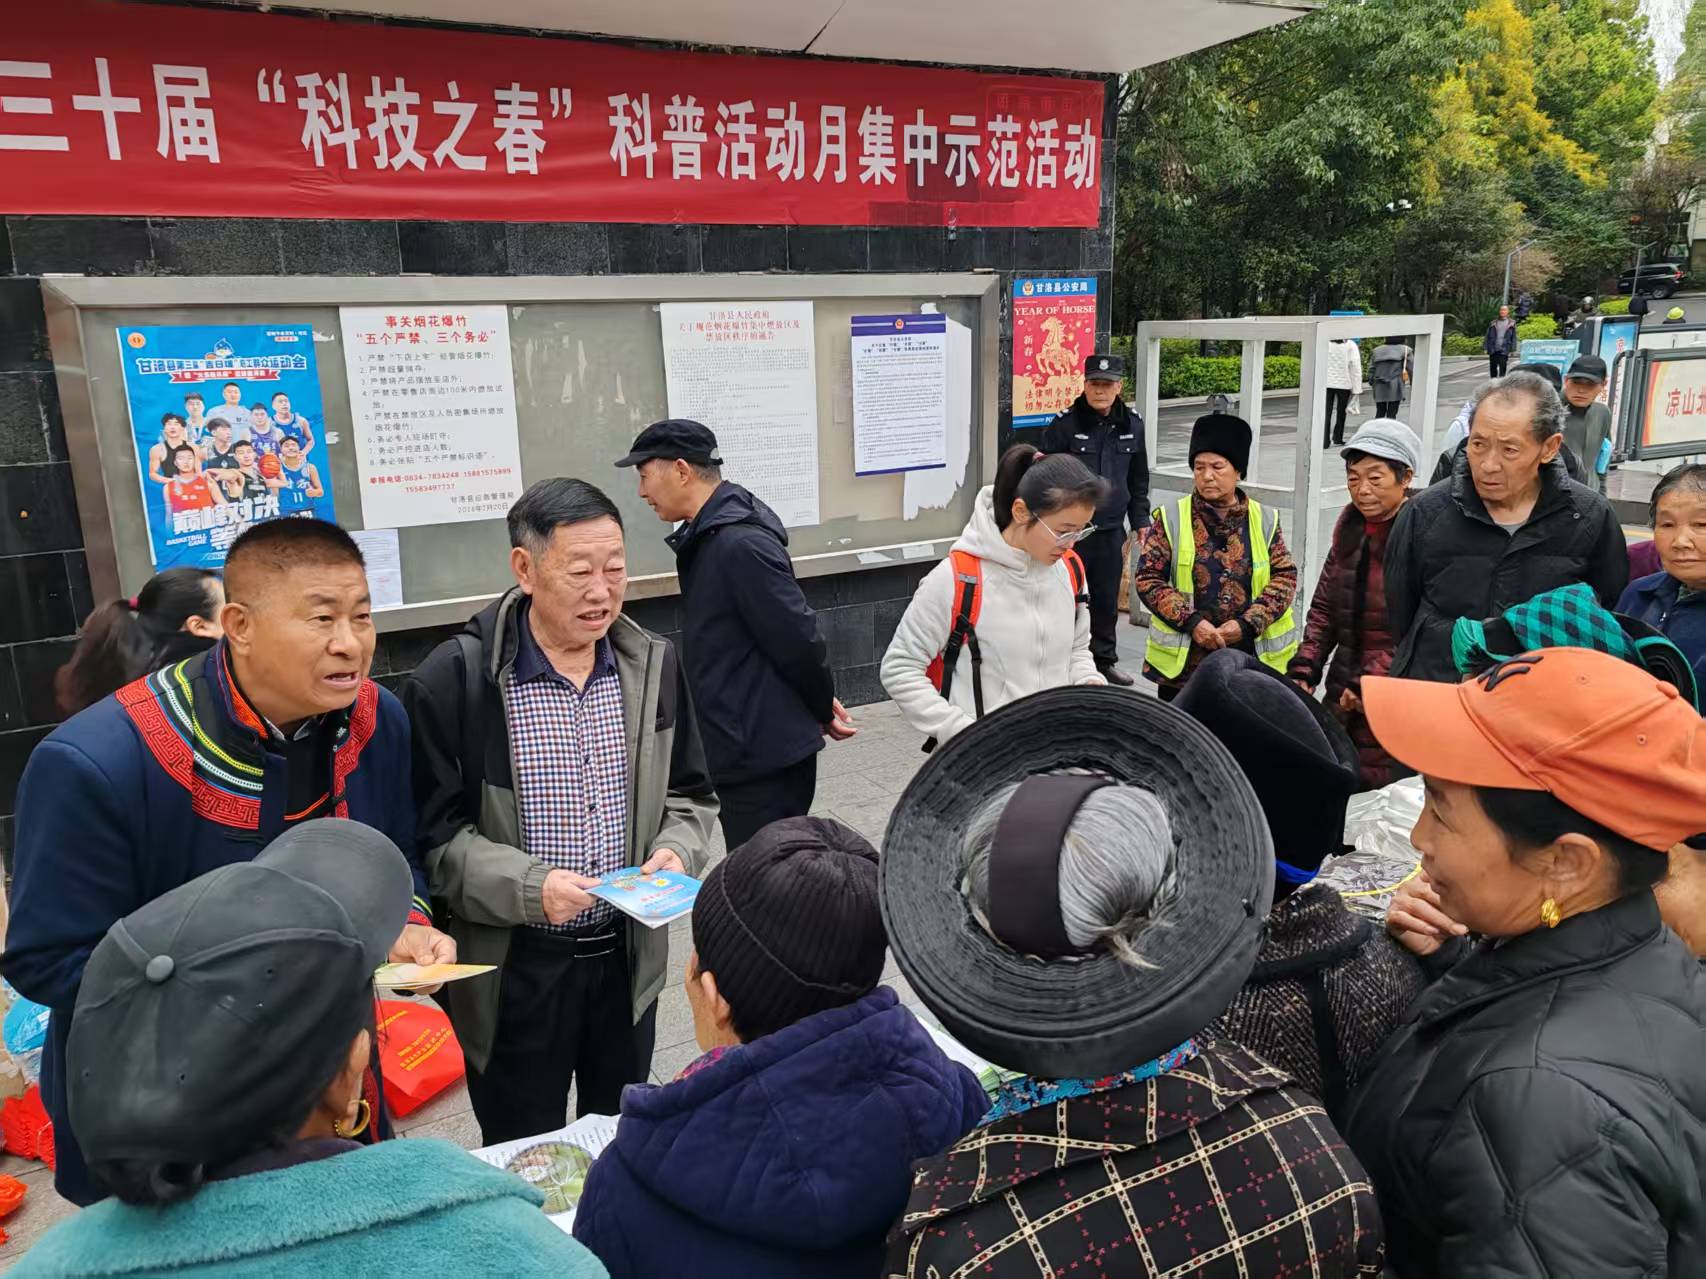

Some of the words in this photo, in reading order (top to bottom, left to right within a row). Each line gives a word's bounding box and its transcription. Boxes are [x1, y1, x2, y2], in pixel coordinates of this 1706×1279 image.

[0, 57, 220, 164] 三十届
[257, 69, 573, 175] “科技之春”
[608, 93, 1096, 189] 科普活动月集中示范活动
[1036, 281, 1088, 293] 甘洛县公安局
[1014, 307, 1043, 316] YEAR
[1045, 306, 1060, 315] OF
[1062, 305, 1096, 315] HORSE
[385, 315, 468, 328] 事关烟花爆竹
[356, 330, 497, 345] “五个严禁、三个务必”
